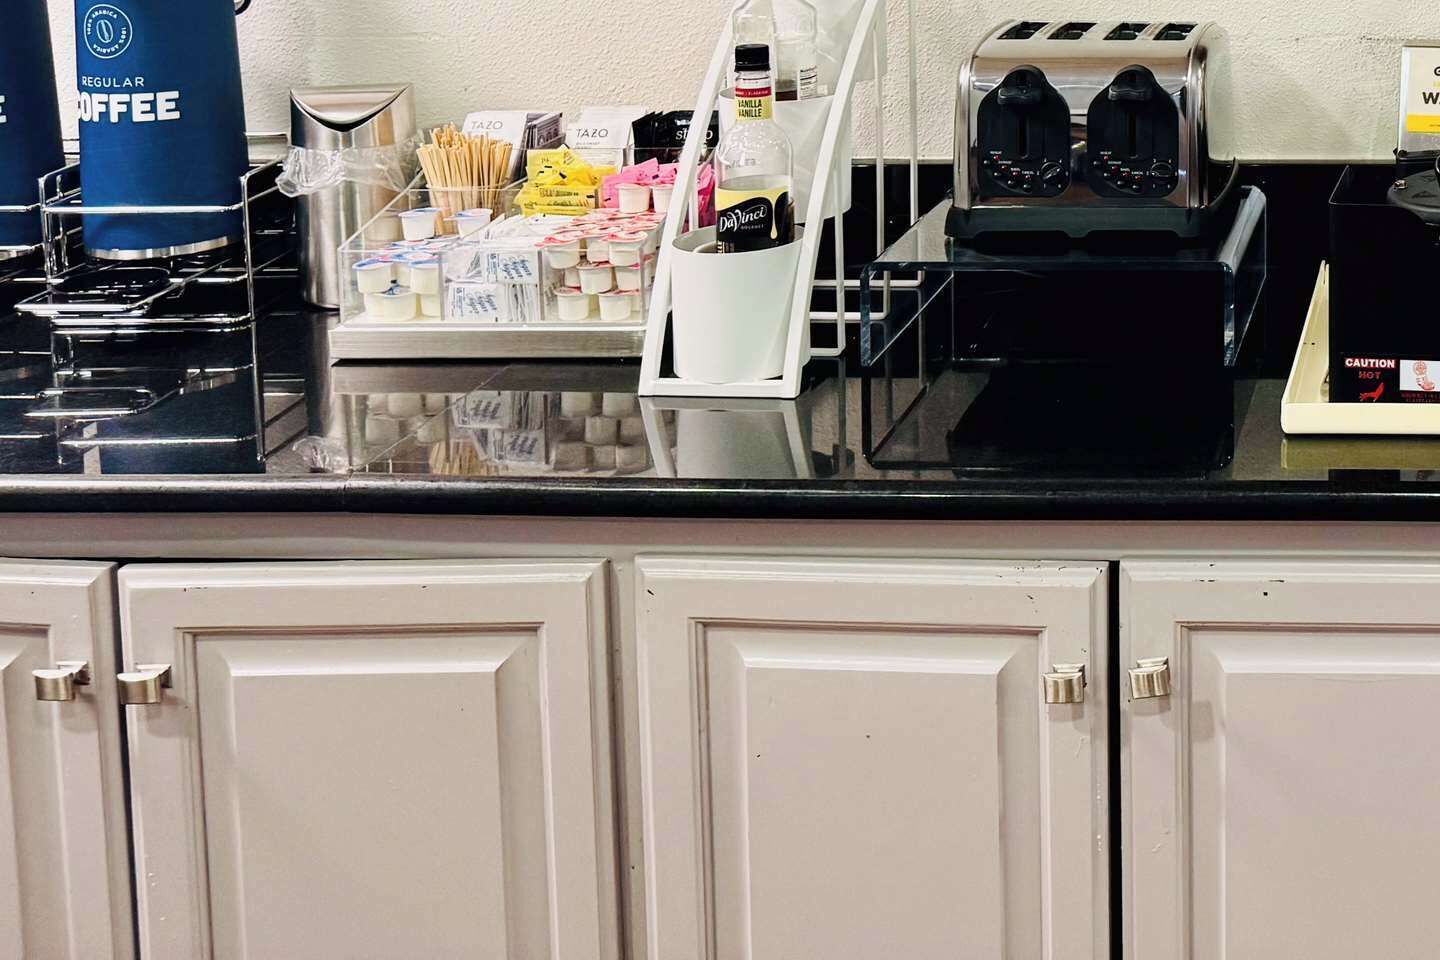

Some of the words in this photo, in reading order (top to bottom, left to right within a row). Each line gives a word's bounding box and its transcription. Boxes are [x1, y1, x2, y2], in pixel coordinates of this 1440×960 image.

[81, 76, 145, 88] REGULAR
[737, 99, 763, 108] VANILLA
[737, 108, 763, 118] VANILLE
[471, 120, 504, 130] TAZO
[575, 128, 609, 138] TAZO
[719, 204, 768, 232] DaVinci
[1344, 358, 1395, 369] CAUTION
[1358, 371, 1382, 380] HOT
